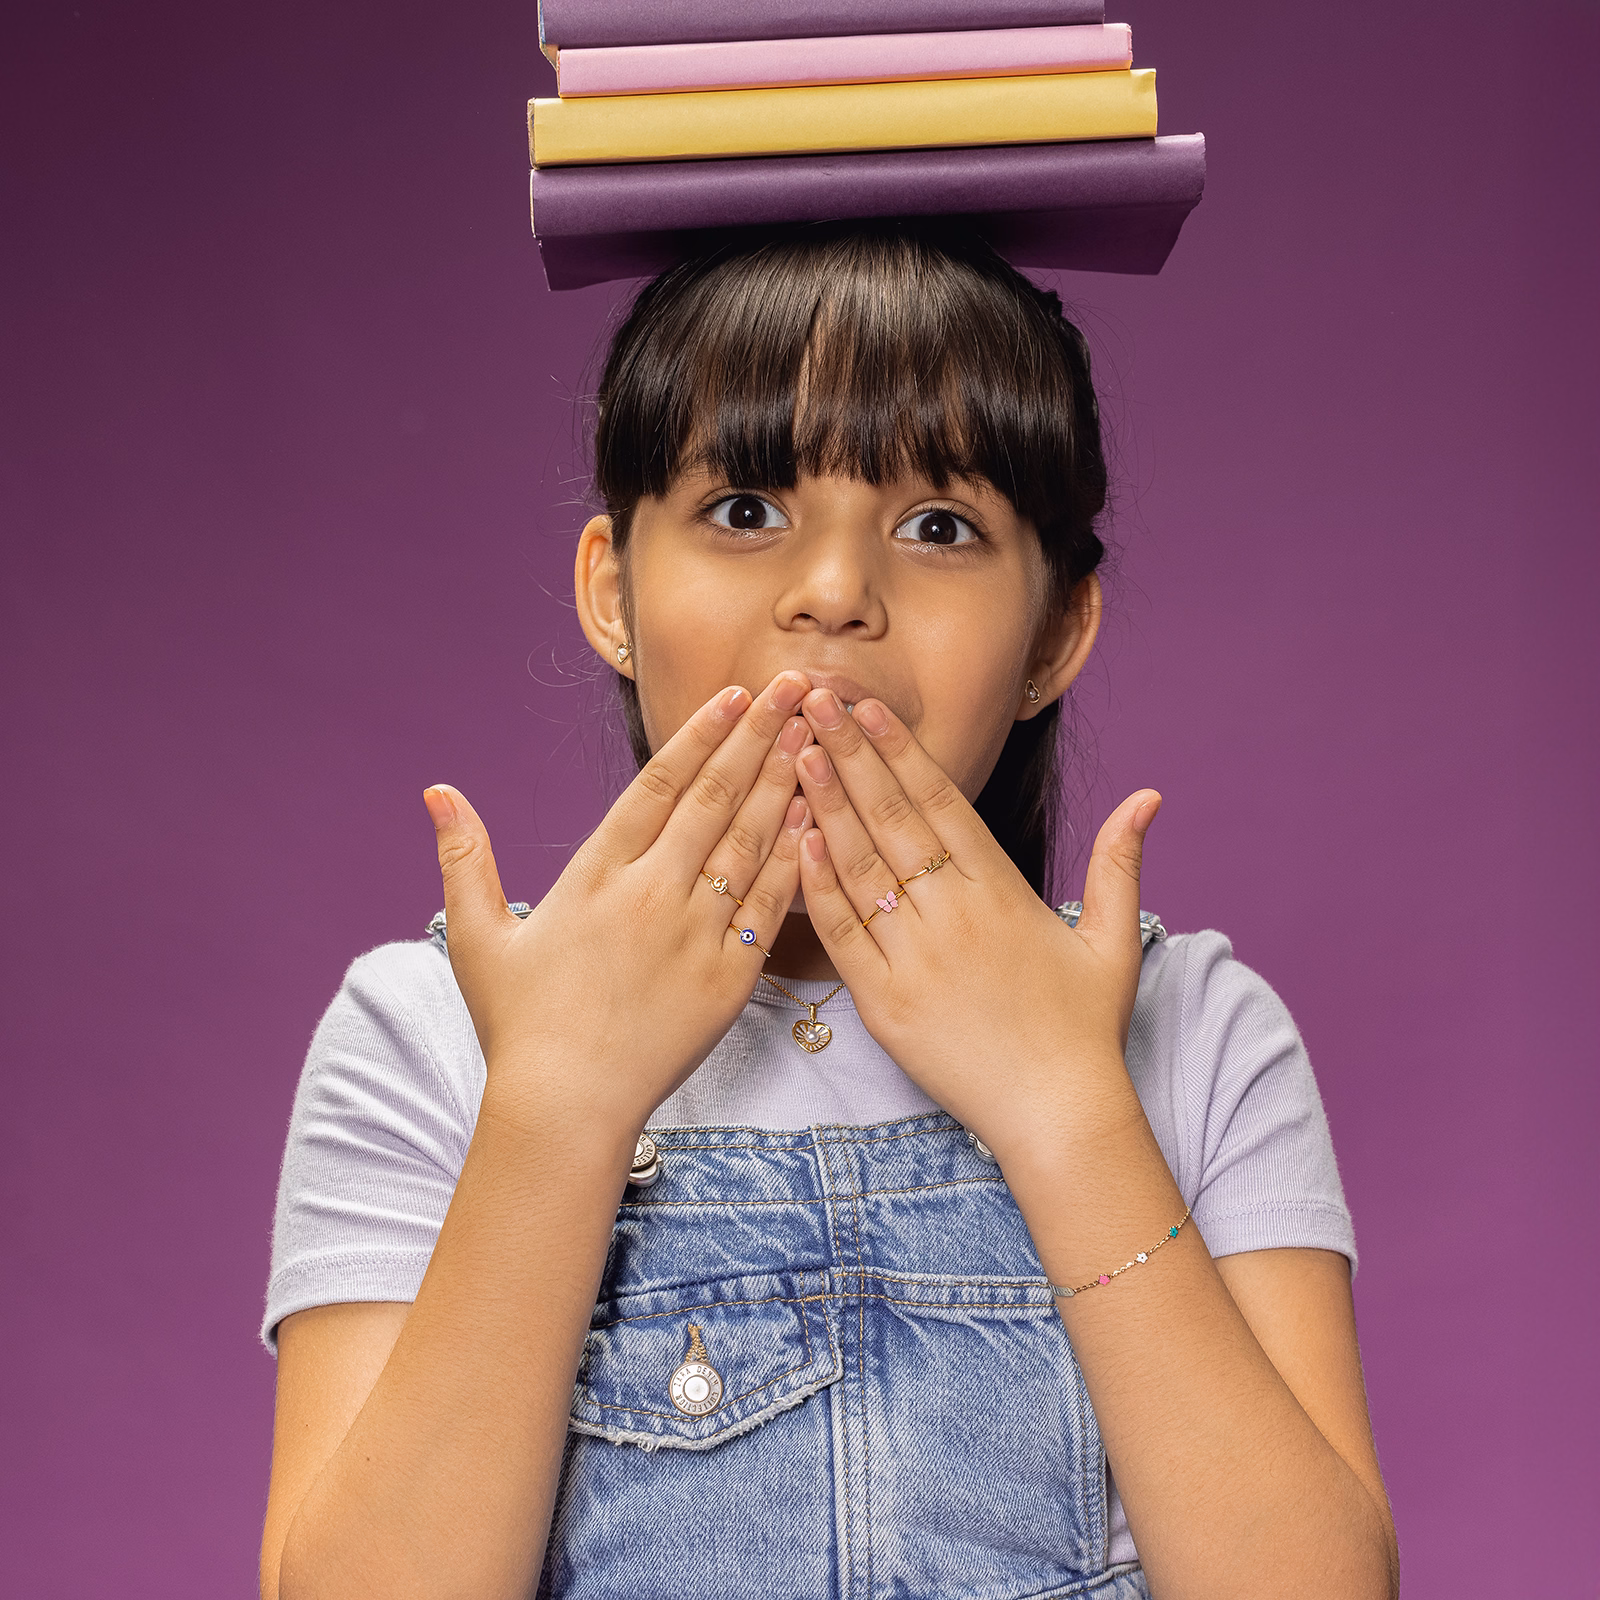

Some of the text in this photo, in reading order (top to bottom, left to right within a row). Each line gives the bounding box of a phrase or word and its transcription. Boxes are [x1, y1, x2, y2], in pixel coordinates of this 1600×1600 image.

[674, 1366, 719, 1412] ZARA DENIM COLLECTION
